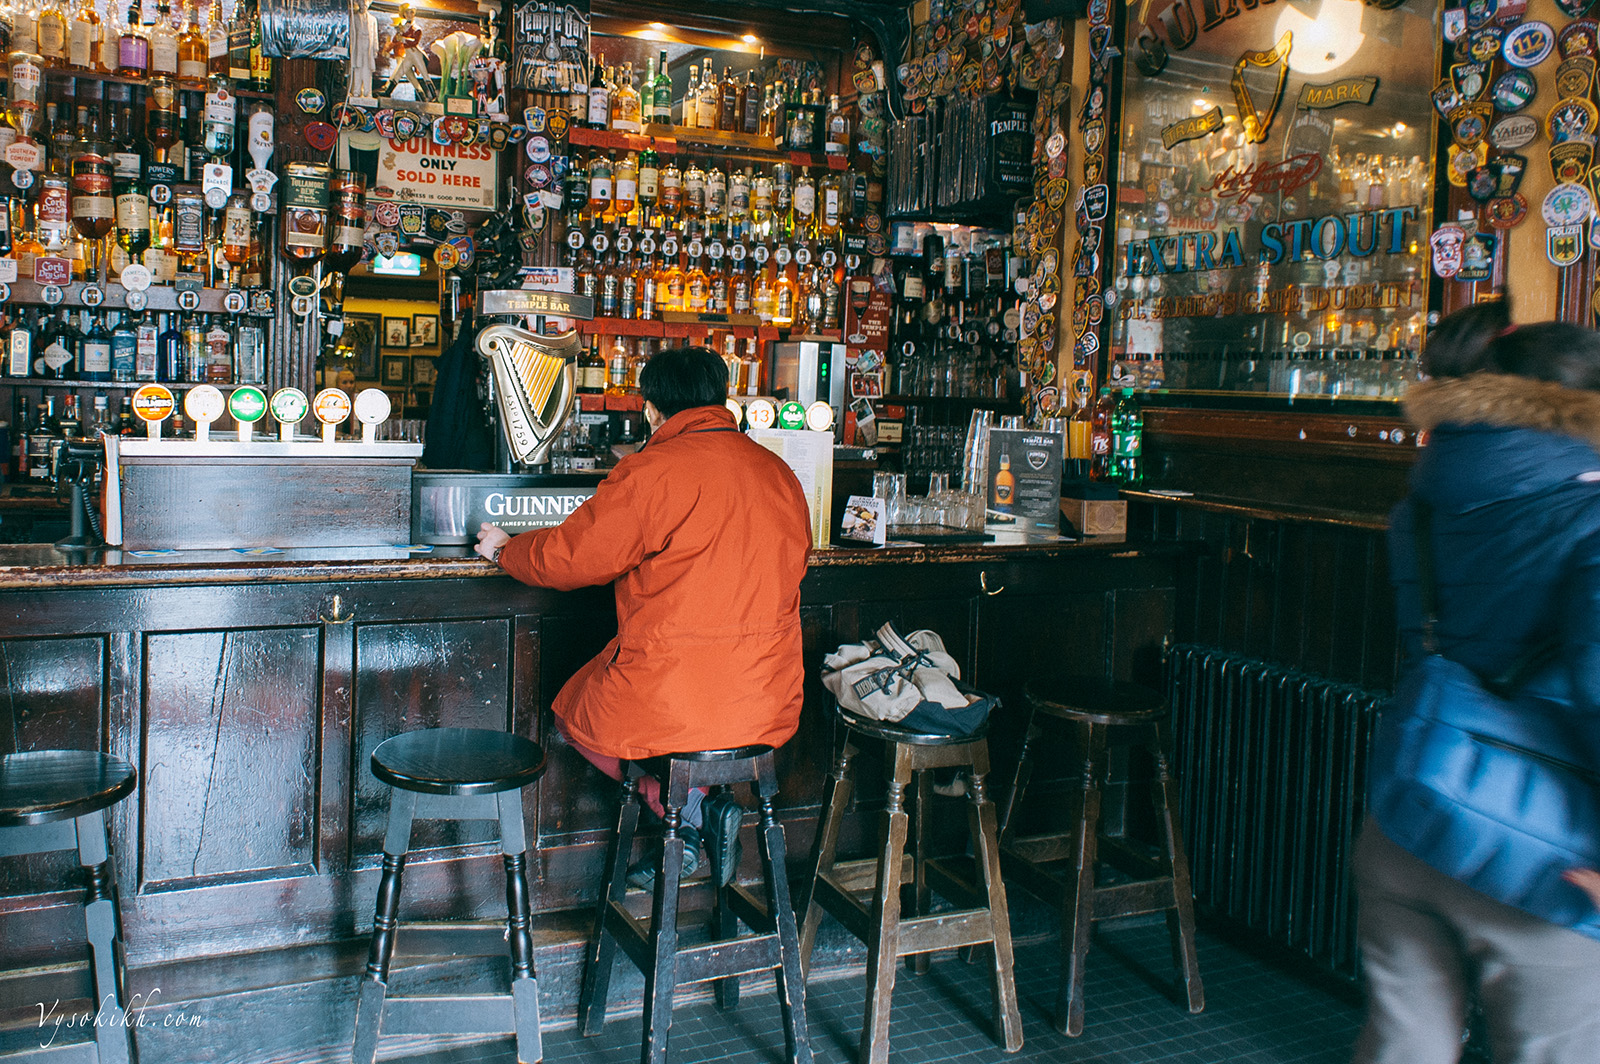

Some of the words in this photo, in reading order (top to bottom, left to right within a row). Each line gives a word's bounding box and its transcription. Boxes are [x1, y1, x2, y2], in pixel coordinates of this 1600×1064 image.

[518, 10, 562, 35] Tempe
[564, 10, 586, 40] Bar
[286, 32, 330, 42] WHISKEY
[526, 32, 544, 44] Irish
[1513, 31, 1545, 55] 112
[13, 71, 40, 82] COMORT
[1306, 82, 1367, 104] MARK
[1432, 86, 1454, 100] POLIC
[527, 113, 546, 121] EMT
[1011, 111, 1027, 120] THE
[990, 120, 1028, 137] TEMPLE
[1165, 113, 1217, 142] TRADE
[1493, 123, 1536, 138] YARDS
[8, 148, 37, 156] SOUTHERN
[10, 155, 35, 163] COMFORT
[419, 157, 458, 171] ONLY
[147, 165, 175, 175] POWERS
[290, 177, 325, 189] TULLAMORE
[396, 169, 437, 184] SOLD
[442, 173, 481, 189] HERE
[44, 197, 66, 207] Cork
[119, 194, 146, 205] JAMESON
[1550, 225, 1580, 237] POLIZEI
[1124, 226, 1246, 277] EXTRA
[1259, 205, 1418, 267] STOUT
[41, 261, 64, 272] Cork
[38, 269, 54, 279] Dry
[54, 270, 67, 280] Gin
[531, 294, 548, 302] THE
[1120, 298, 1146, 320] ST.
[1243, 286, 1303, 313] GATE
[1310, 281, 1415, 311] DUBLIN
[507, 300, 548, 310] TEMPLE
[550, 302, 571, 312] BAR
[751, 409, 770, 423] 13
[511, 418, 528, 446] 1759
[1093, 437, 1110, 452] TK
[484, 492, 596, 517] GUINNES
